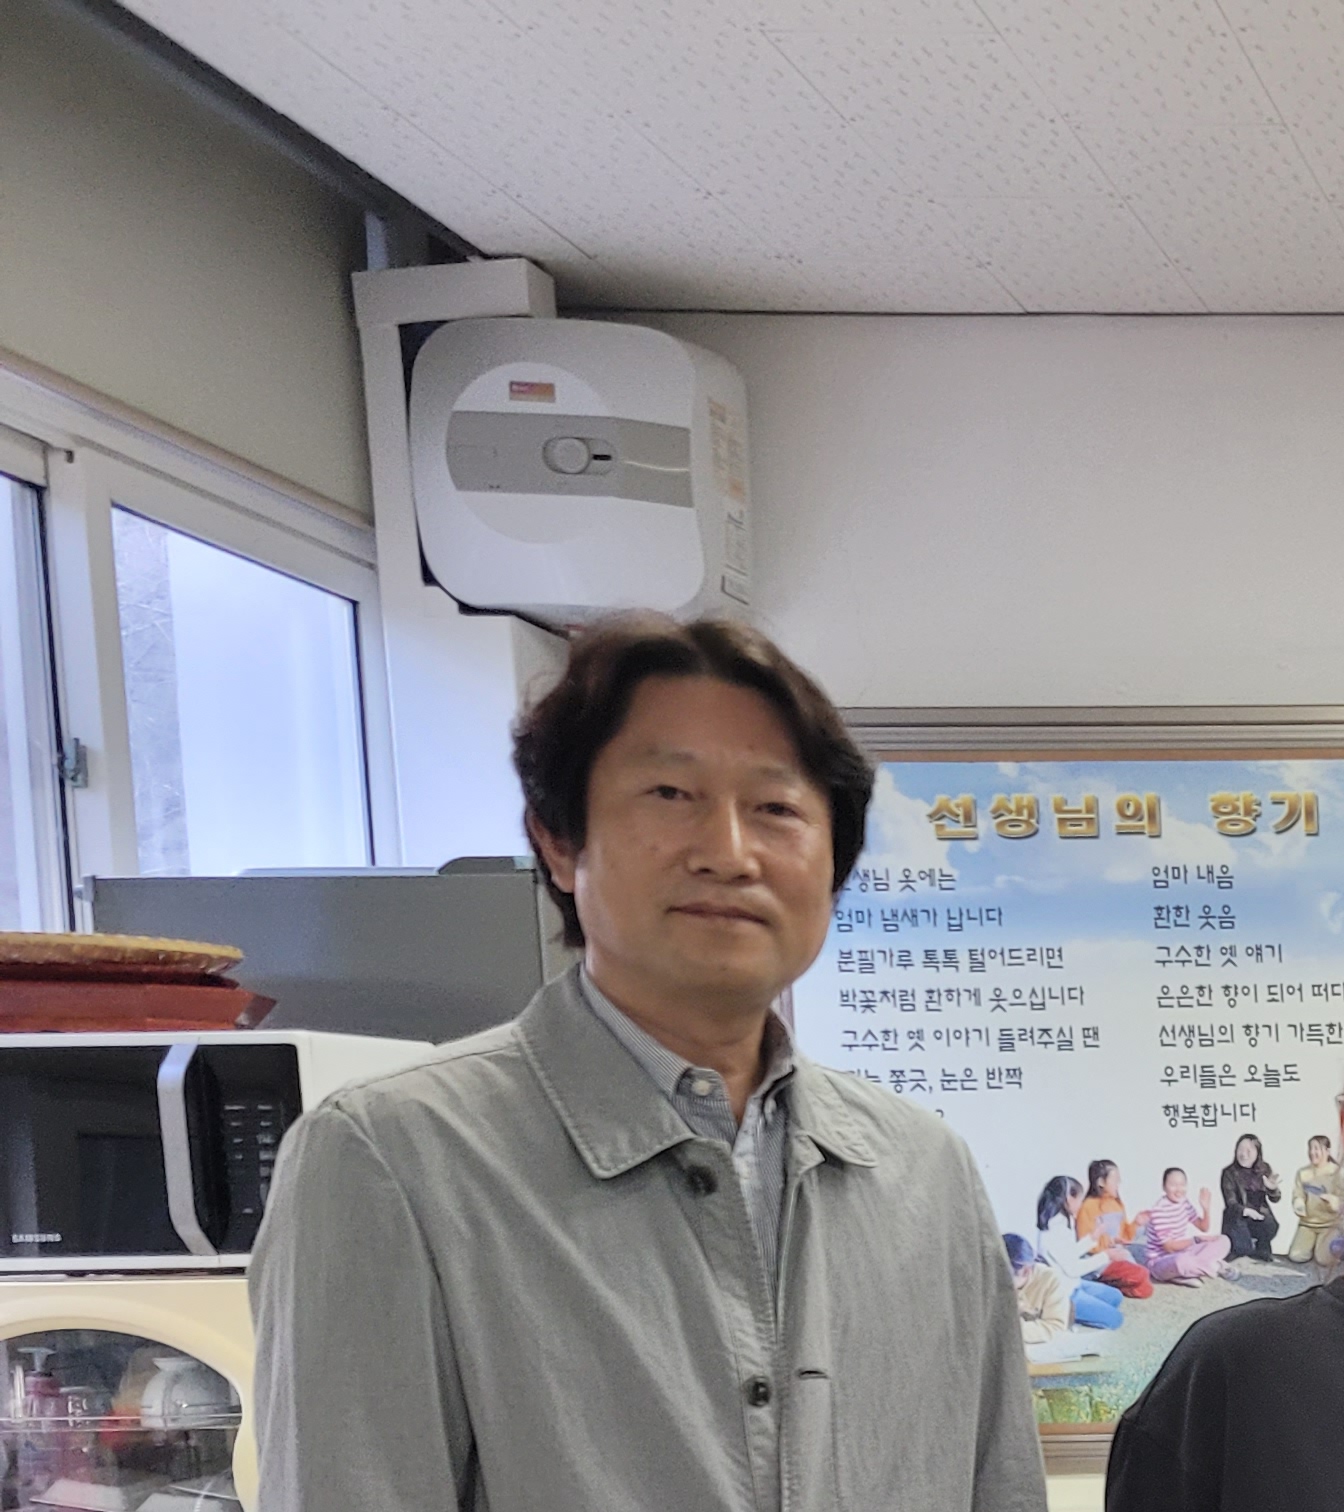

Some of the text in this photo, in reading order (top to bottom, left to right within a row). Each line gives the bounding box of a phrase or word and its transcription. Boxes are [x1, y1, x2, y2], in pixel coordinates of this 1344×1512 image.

[926, 791, 1320, 840] 선생님의 향기
[898, 868, 957, 892] 옷에는
[1151, 864, 1235, 889] 엄마 내음
[835, 906, 1004, 933] 엄마 냄새가 납니다
[1153, 904, 1237, 930] 환한 웃음
[837, 946, 1065, 974] 분필가루 톡톡 털어드리면
[1155, 943, 1283, 967] 구수한 옛 얘기
[839, 985, 1086, 1013] 박꽃처럼 환하게 웃으십니다
[1156, 983, 1304, 1009] 은은한 향이 되어
[840, 1025, 1101, 1052] 구수한 옛 이야기 들려주실 땐
[1158, 1022, 1344, 1048] 선생님의 향기 가득한
[889, 1069, 934, 1095] 쫑긋,
[940, 1067, 979, 1092] 눈은
[986, 1066, 1023, 1090] 반짝
[1160, 1063, 1301, 1089] 우리들은 오늘도
[1161, 1102, 1257, 1129] 행복합니다
